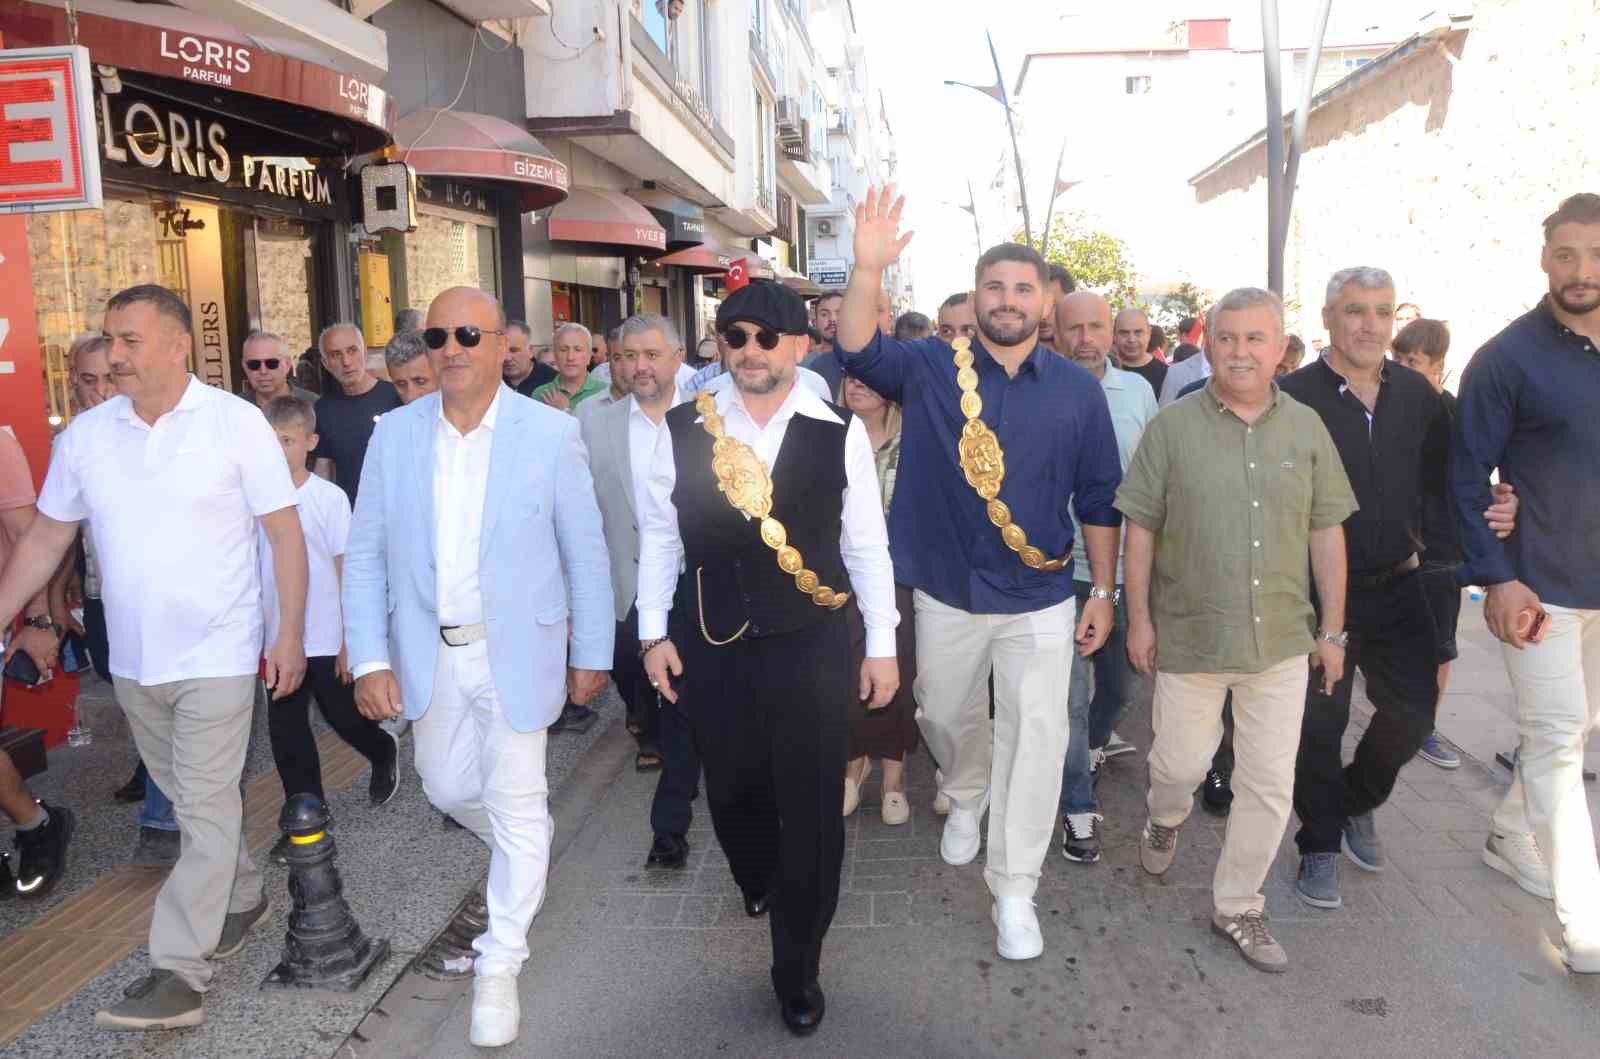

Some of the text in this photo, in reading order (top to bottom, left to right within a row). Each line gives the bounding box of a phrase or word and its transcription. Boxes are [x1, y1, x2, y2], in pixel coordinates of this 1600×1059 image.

[183, 66, 232, 86] PARFUM
[339, 74, 369, 105] LOR
[242, 154, 332, 205] PARFUM
[514, 157, 553, 181] GİZEM
